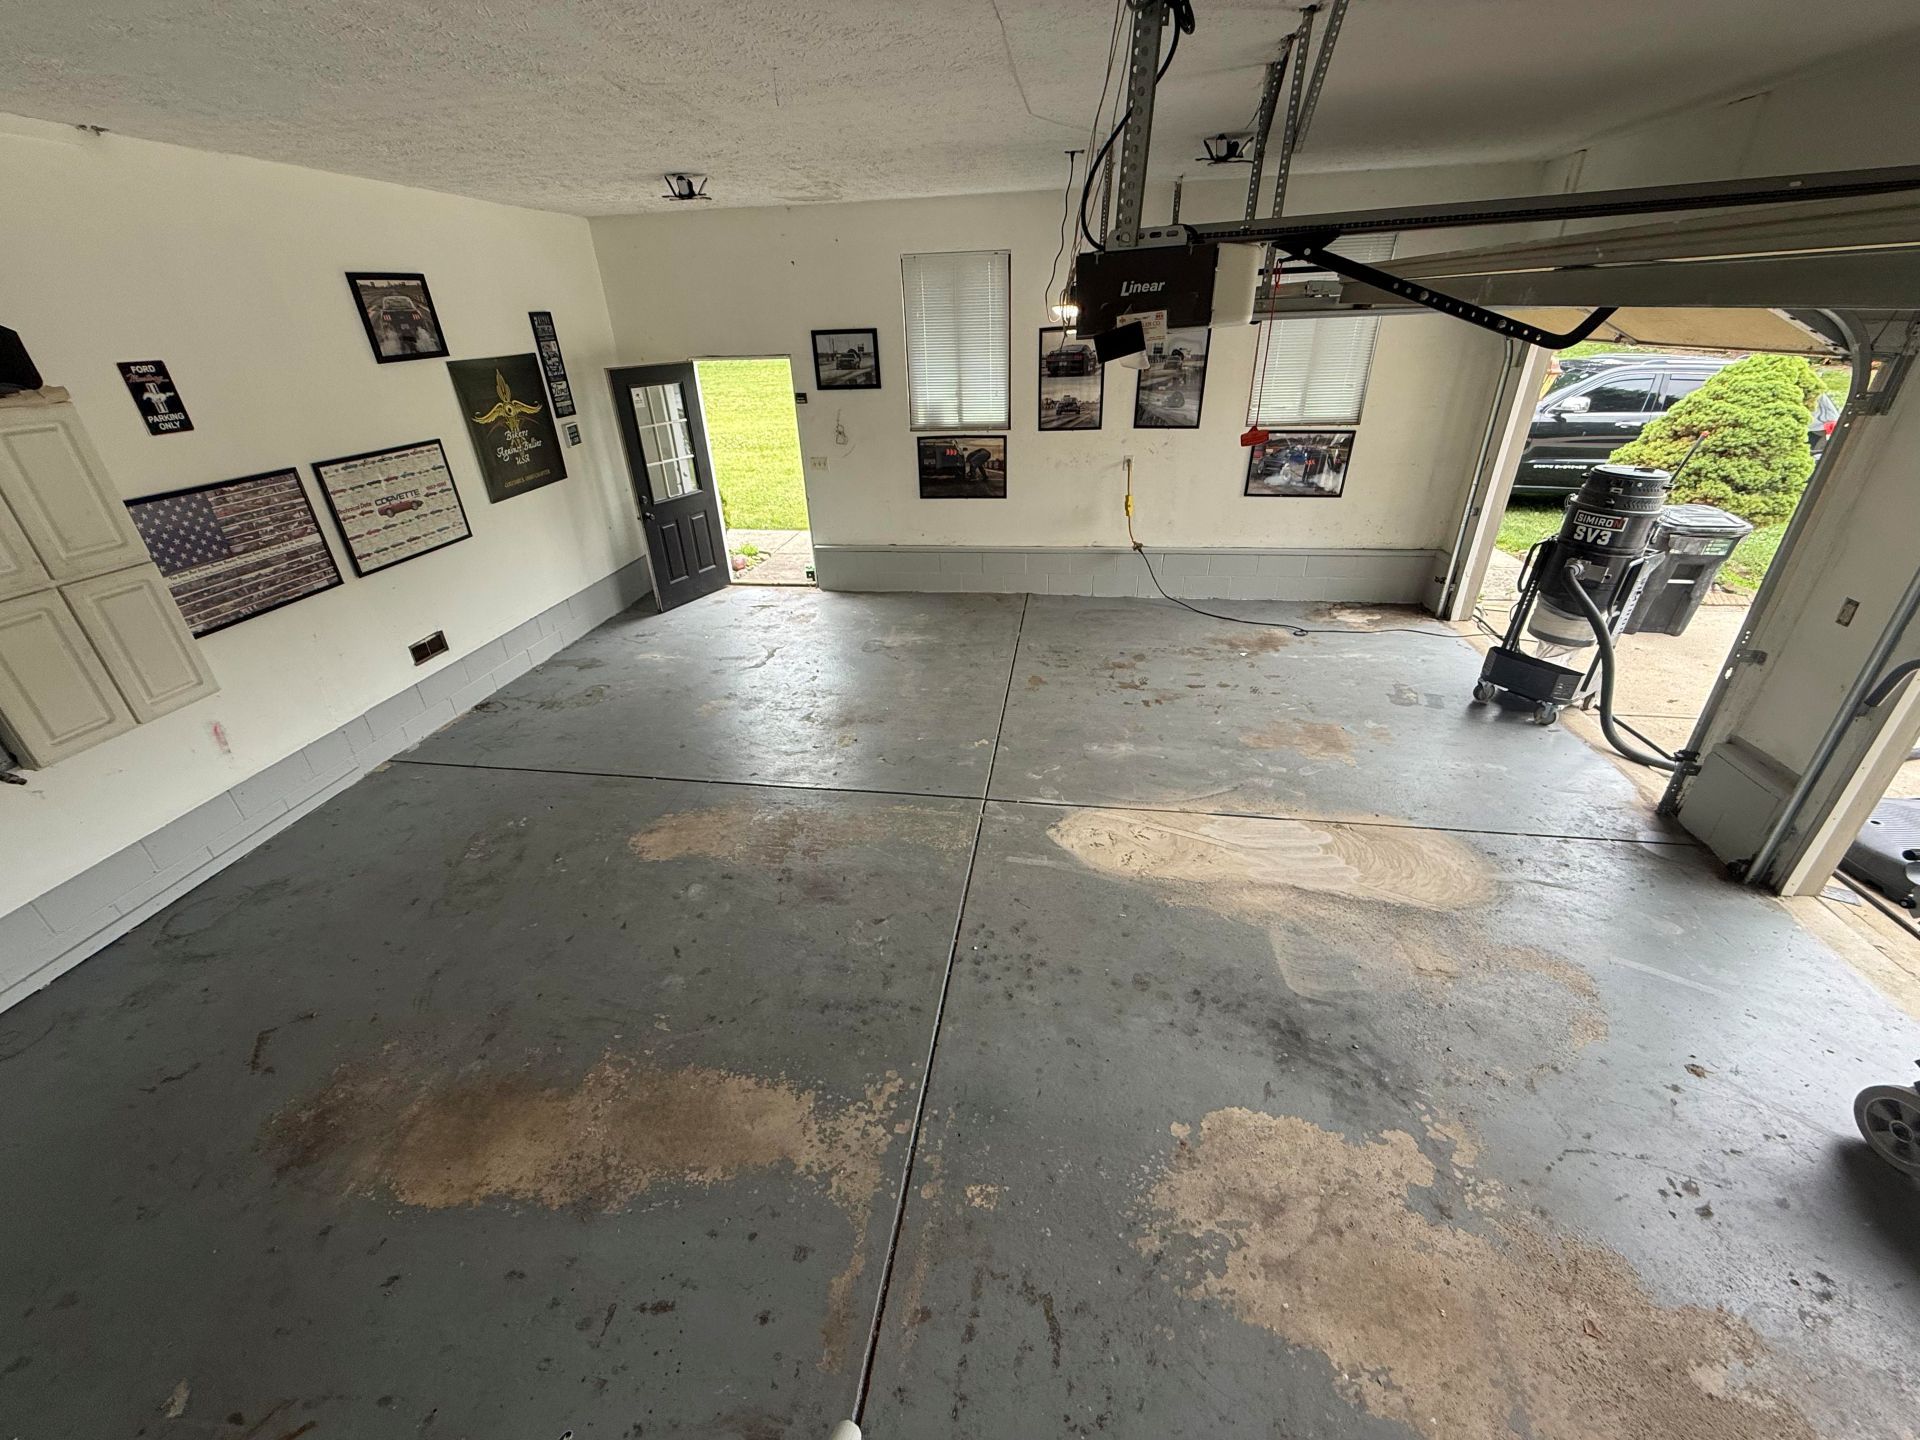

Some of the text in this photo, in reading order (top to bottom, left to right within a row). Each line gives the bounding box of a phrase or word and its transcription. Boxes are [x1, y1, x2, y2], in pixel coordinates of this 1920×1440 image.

[1120, 280, 1166, 297] Linear
[130, 364, 156, 374] FORD
[147, 412, 185, 424] PARKING
[158, 420, 181, 431] ONLY
[504, 429, 529, 441] Bikers
[496, 446, 522, 462] Against
[374, 489, 420, 507] CORVETTE
[1576, 513, 1624, 529] SIMIRON
[1573, 525, 1612, 546] SV3
